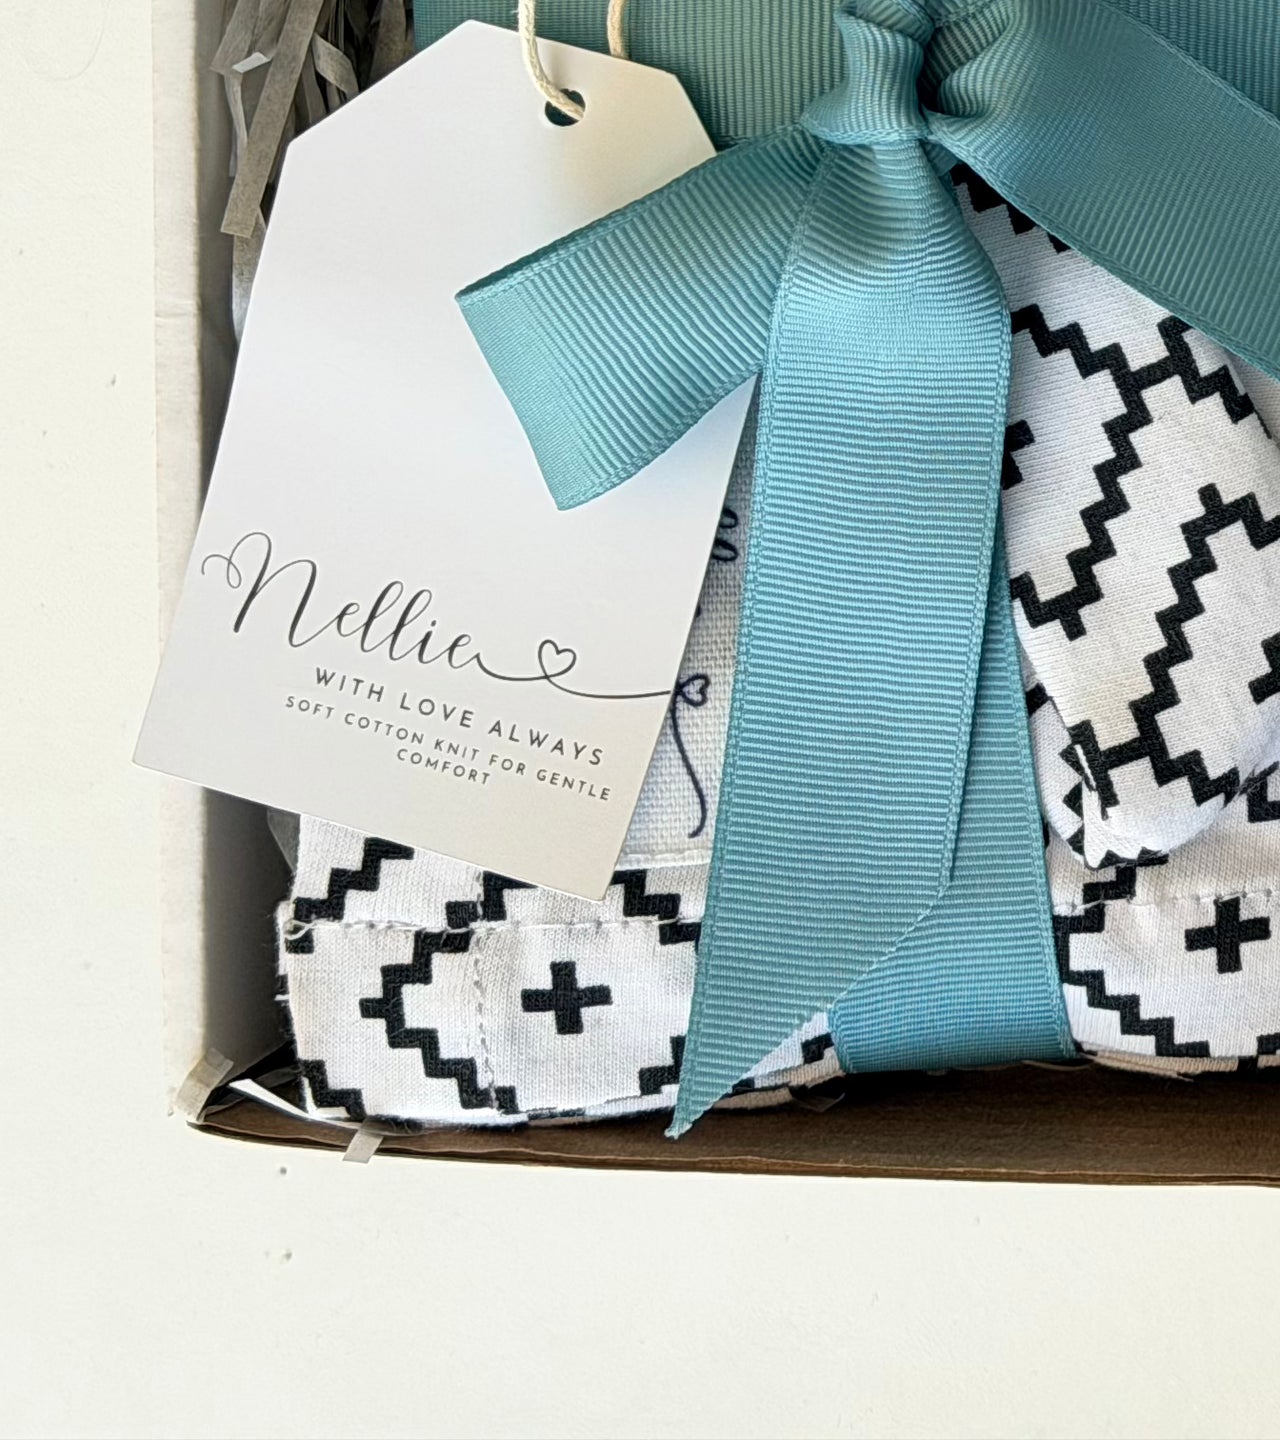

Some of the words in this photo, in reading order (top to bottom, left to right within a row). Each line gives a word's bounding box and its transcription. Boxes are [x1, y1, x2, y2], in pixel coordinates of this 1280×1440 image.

[201, 532, 540, 680] Nellie
[285, 695, 335, 720] SOFT
[344, 712, 425, 745] COTTON
[433, 737, 481, 761] KNIT
[488, 753, 526, 776] FOR
[535, 768, 612, 801] GENTLE
[315, 666, 385, 702] WITH
[399, 692, 474, 728] LOVE
[488, 719, 604, 766] ALWAYS
[396, 747, 491, 786] COMFORT
